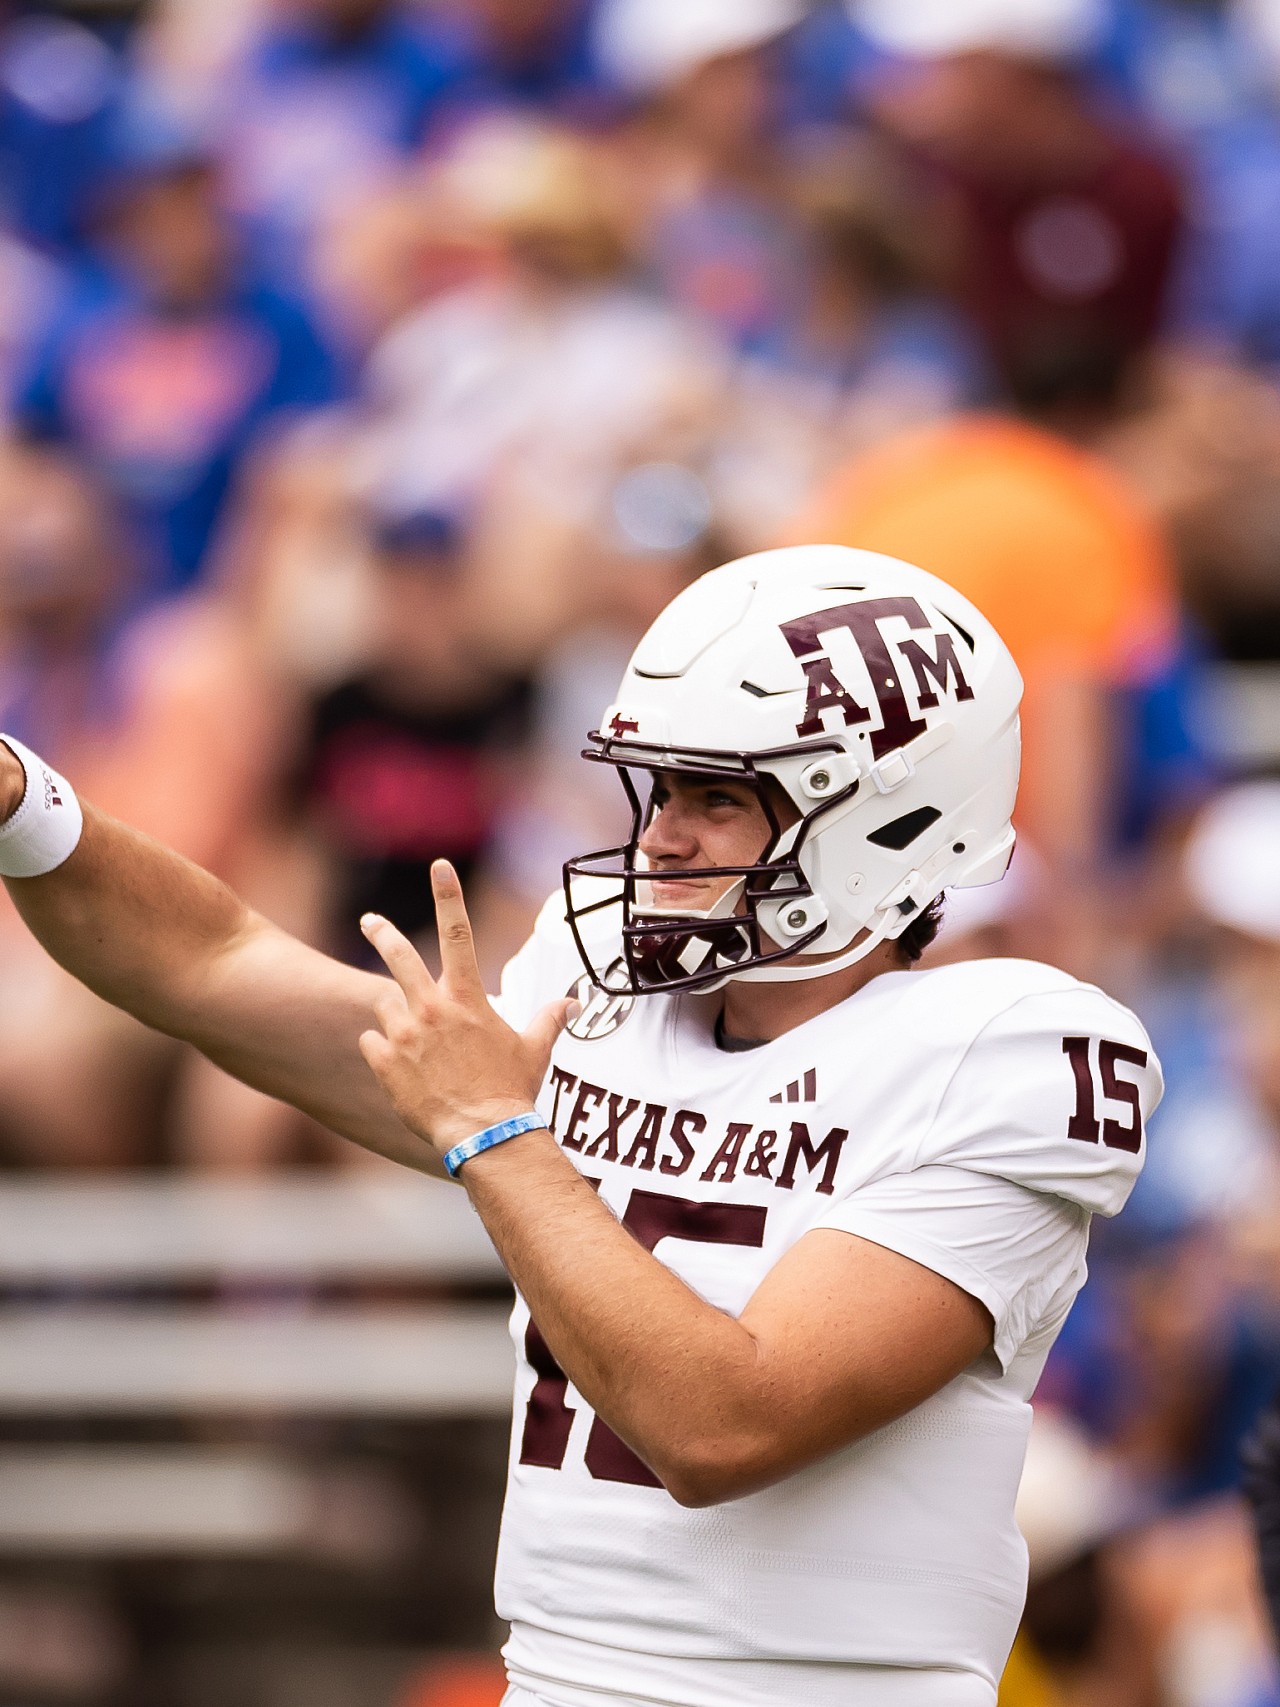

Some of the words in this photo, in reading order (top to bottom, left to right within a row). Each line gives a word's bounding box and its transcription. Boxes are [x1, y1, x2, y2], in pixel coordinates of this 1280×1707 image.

[548, 1064, 708, 1178] TEXAS
[699, 1121, 849, 1196] A&M
[1062, 1036, 1148, 1155] 15
